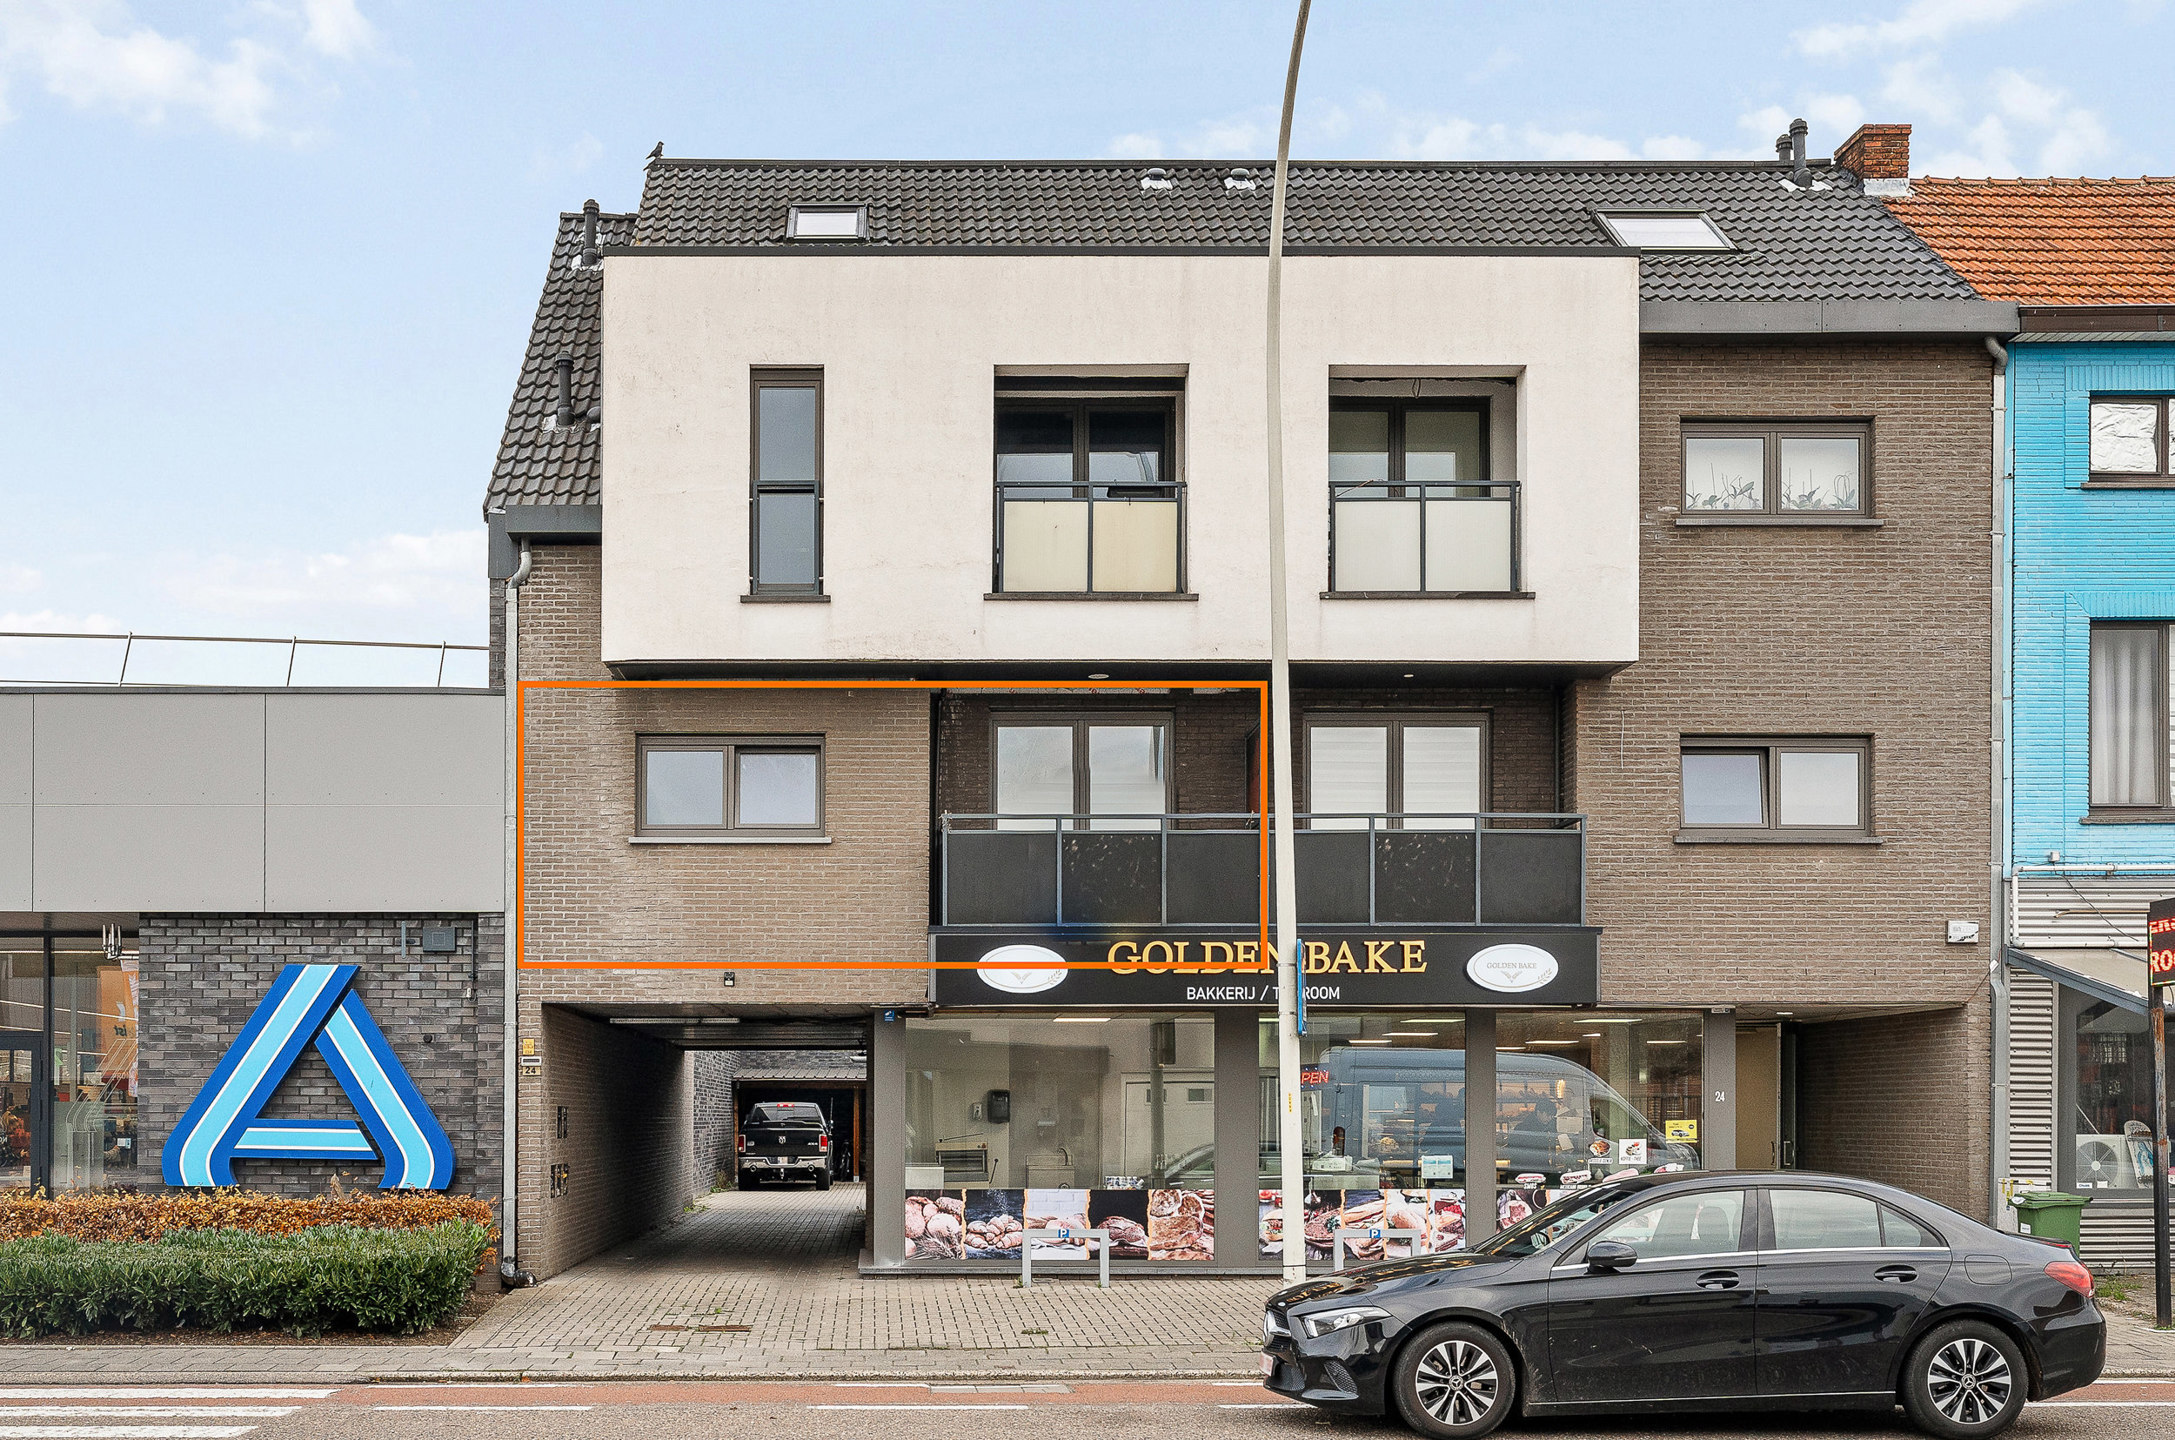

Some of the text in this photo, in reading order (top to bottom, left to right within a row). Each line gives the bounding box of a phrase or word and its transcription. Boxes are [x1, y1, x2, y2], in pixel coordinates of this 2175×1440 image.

[1304, 940, 1428, 974] BAKE
[1186, 986, 1256, 1000] BAKKERIJ
[1272, 986, 1340, 1000] TROOM
[525, 1066, 536, 1074] 24
[1301, 1071, 1329, 1084] PEN
[1715, 1091, 1725, 1102] 24
